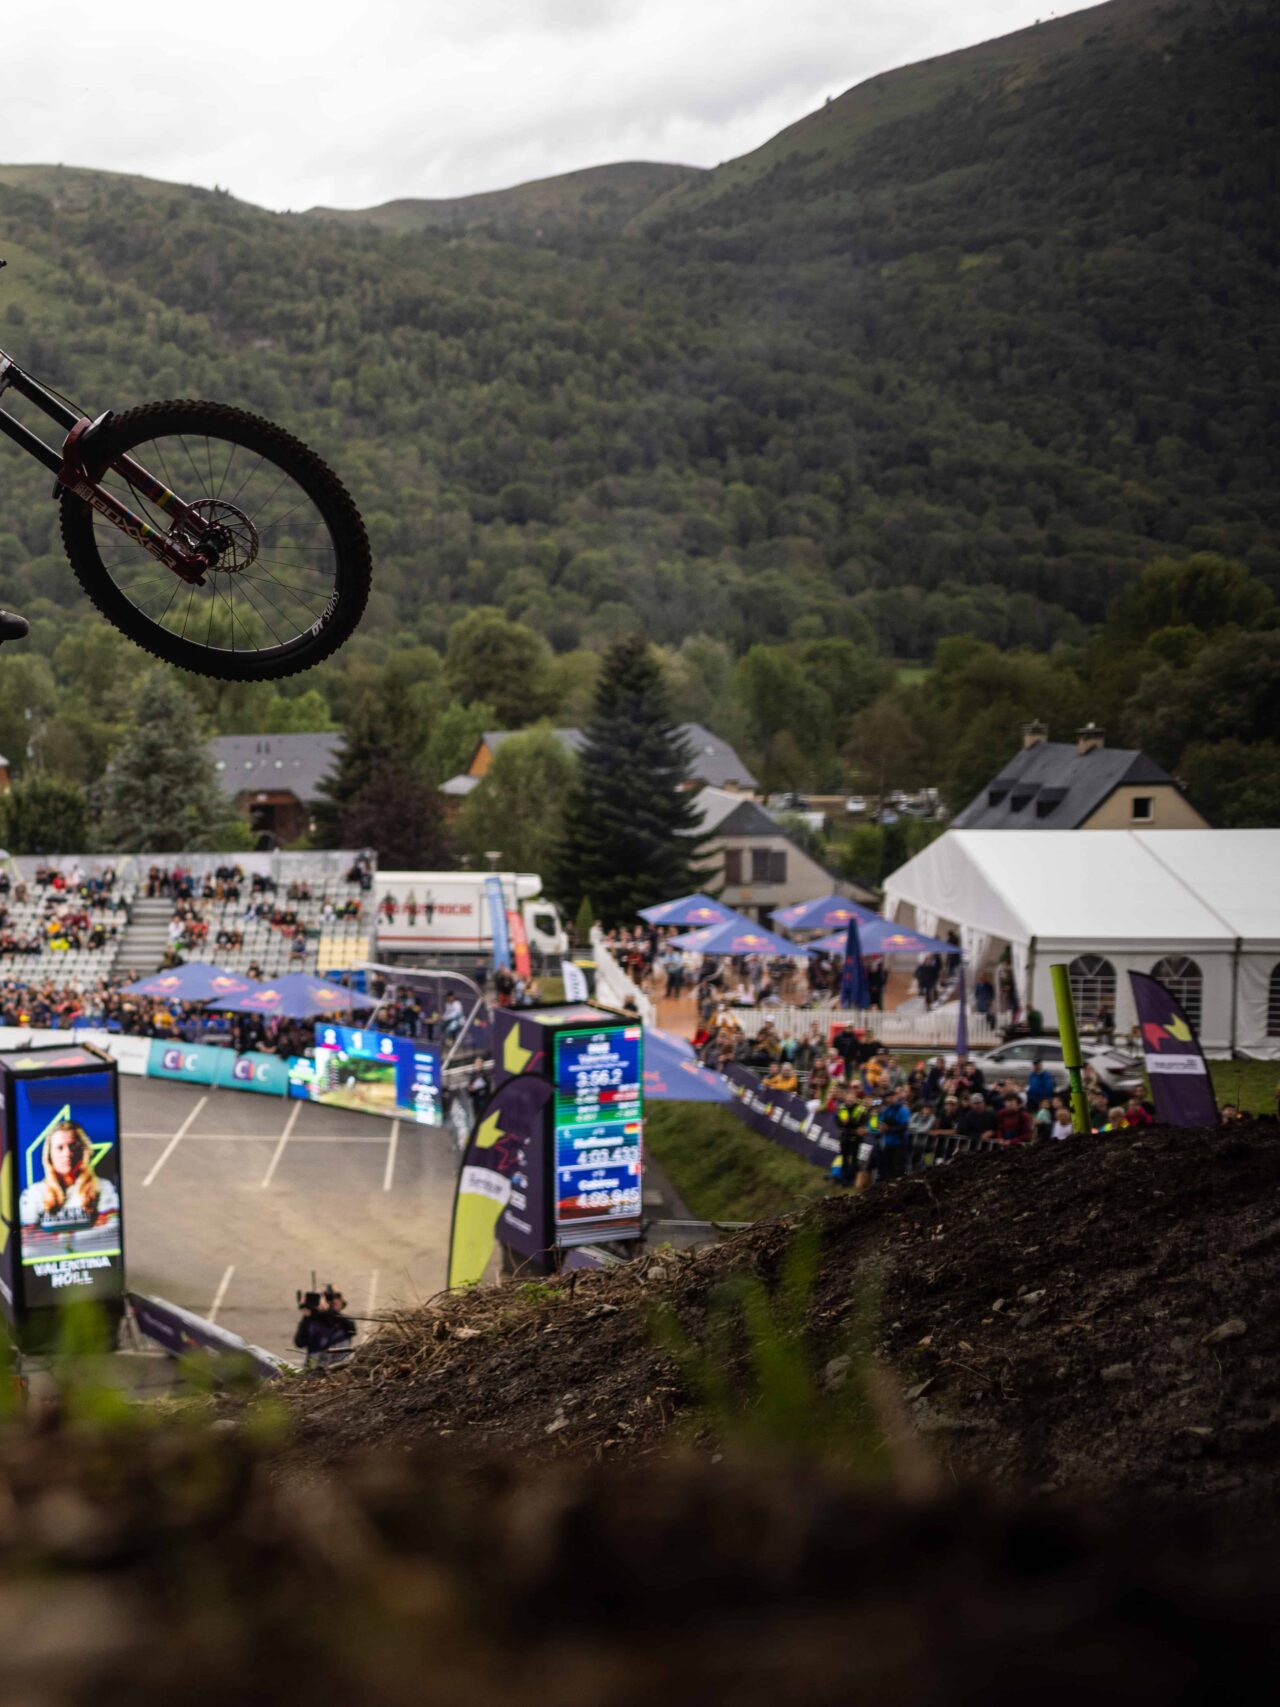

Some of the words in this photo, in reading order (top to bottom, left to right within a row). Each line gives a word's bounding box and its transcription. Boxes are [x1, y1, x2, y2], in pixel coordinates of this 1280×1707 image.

[89, 495, 177, 569] BOXXER
[311, 617, 324, 637] DT
[33, 1256, 111, 1277] VALENTINA
